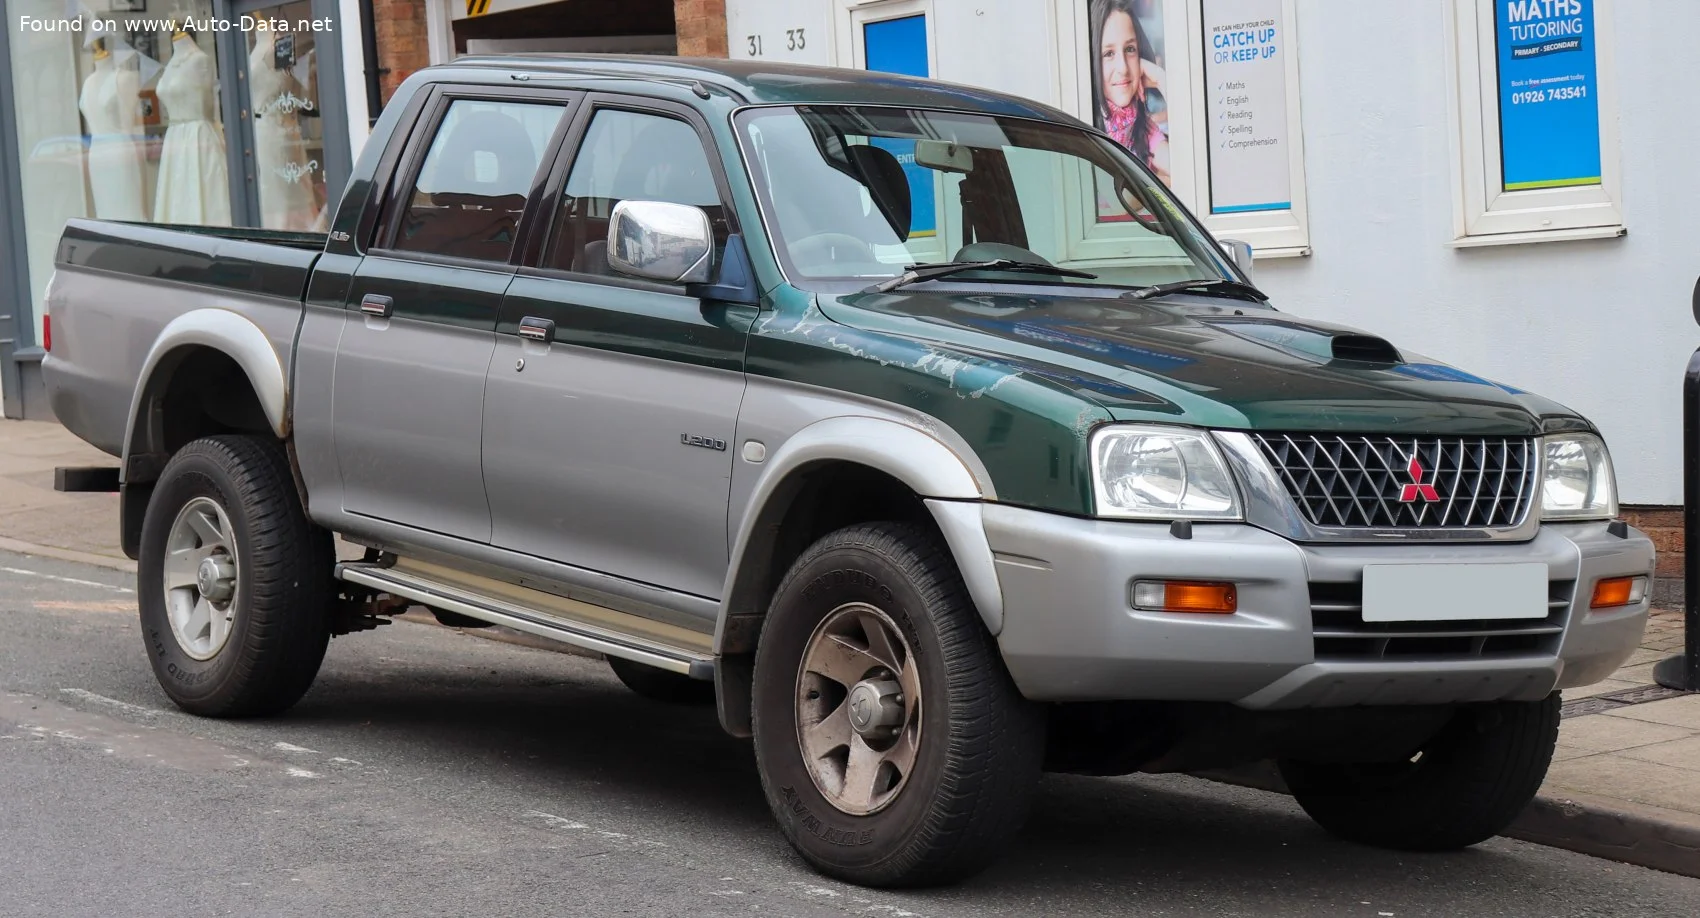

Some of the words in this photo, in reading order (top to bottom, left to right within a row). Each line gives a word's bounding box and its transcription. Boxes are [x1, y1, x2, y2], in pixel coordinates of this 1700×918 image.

[1507, 0, 1582, 23] MATHS
[1246, 21, 1259, 29] YOUR
[1509, 18, 1583, 41] TUTORING
[747, 35, 763, 57] 31
[786, 28, 806, 51] 33
[1213, 31, 1255, 49] CATCH
[1258, 28, 1276, 44] UP
[1213, 51, 1229, 64] OR
[1231, 48, 1259, 62] KEEP
[1261, 46, 1276, 59] UP
[1514, 46, 1540, 56] PRIMARY
[1543, 40, 1579, 52] SECONDARY
[1226, 81, 1246, 90] Maths
[1540, 75, 1570, 84] assessment
[1570, 73, 1585, 81] today
[1226, 94, 1249, 106] English
[1512, 90, 1545, 105] 01926
[1547, 85, 1587, 101] 743541
[1227, 110, 1253, 120] Reading
[1227, 125, 1253, 136] Spelling
[1228, 137, 1278, 150] Comprehension
[680, 432, 728, 452] L200
